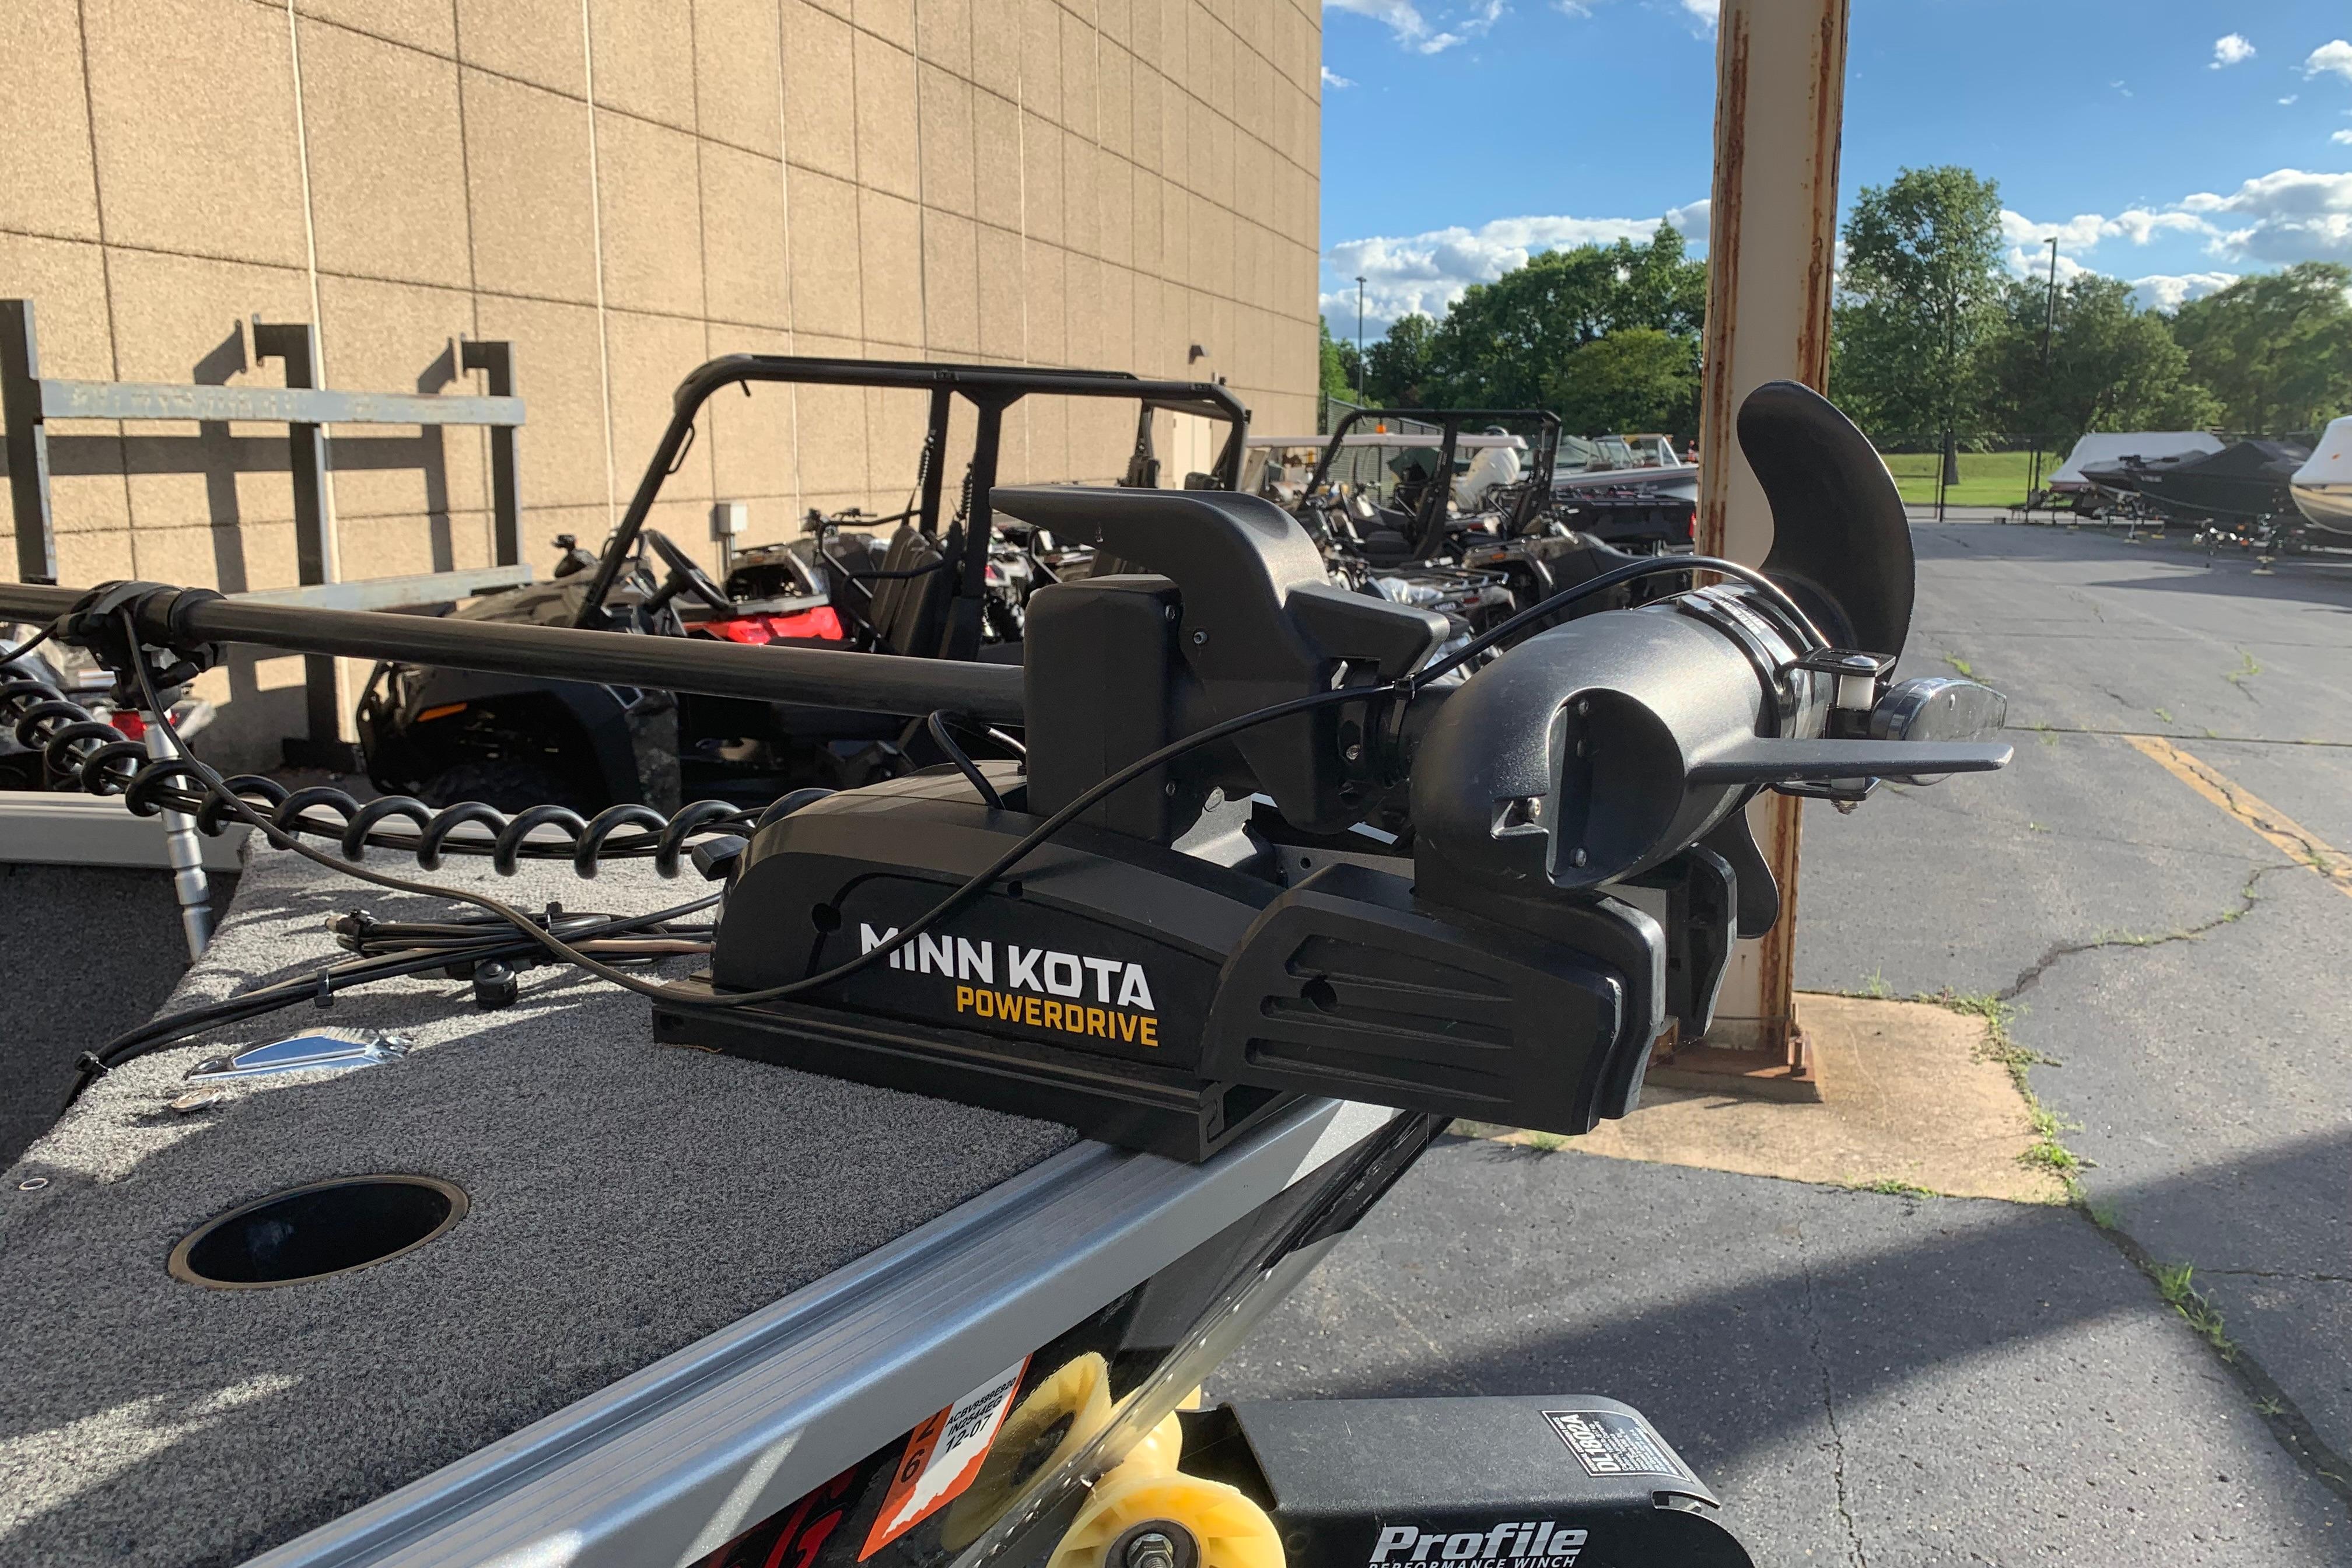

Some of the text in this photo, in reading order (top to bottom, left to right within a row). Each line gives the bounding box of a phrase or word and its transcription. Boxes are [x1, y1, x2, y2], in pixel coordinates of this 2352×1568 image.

[860, 923, 1155, 1011] MINN KOTA
[957, 985, 1158, 1047] POWERDRIVE
[945, 1412, 993, 1454] 12-07
[947, 1395, 1003, 1437] IN2544EG
[1560, 1414, 1622, 1471] DL1802A
[1368, 1521, 1588, 1563] Profile
[1514, 1556, 1576, 1568] WINCH
